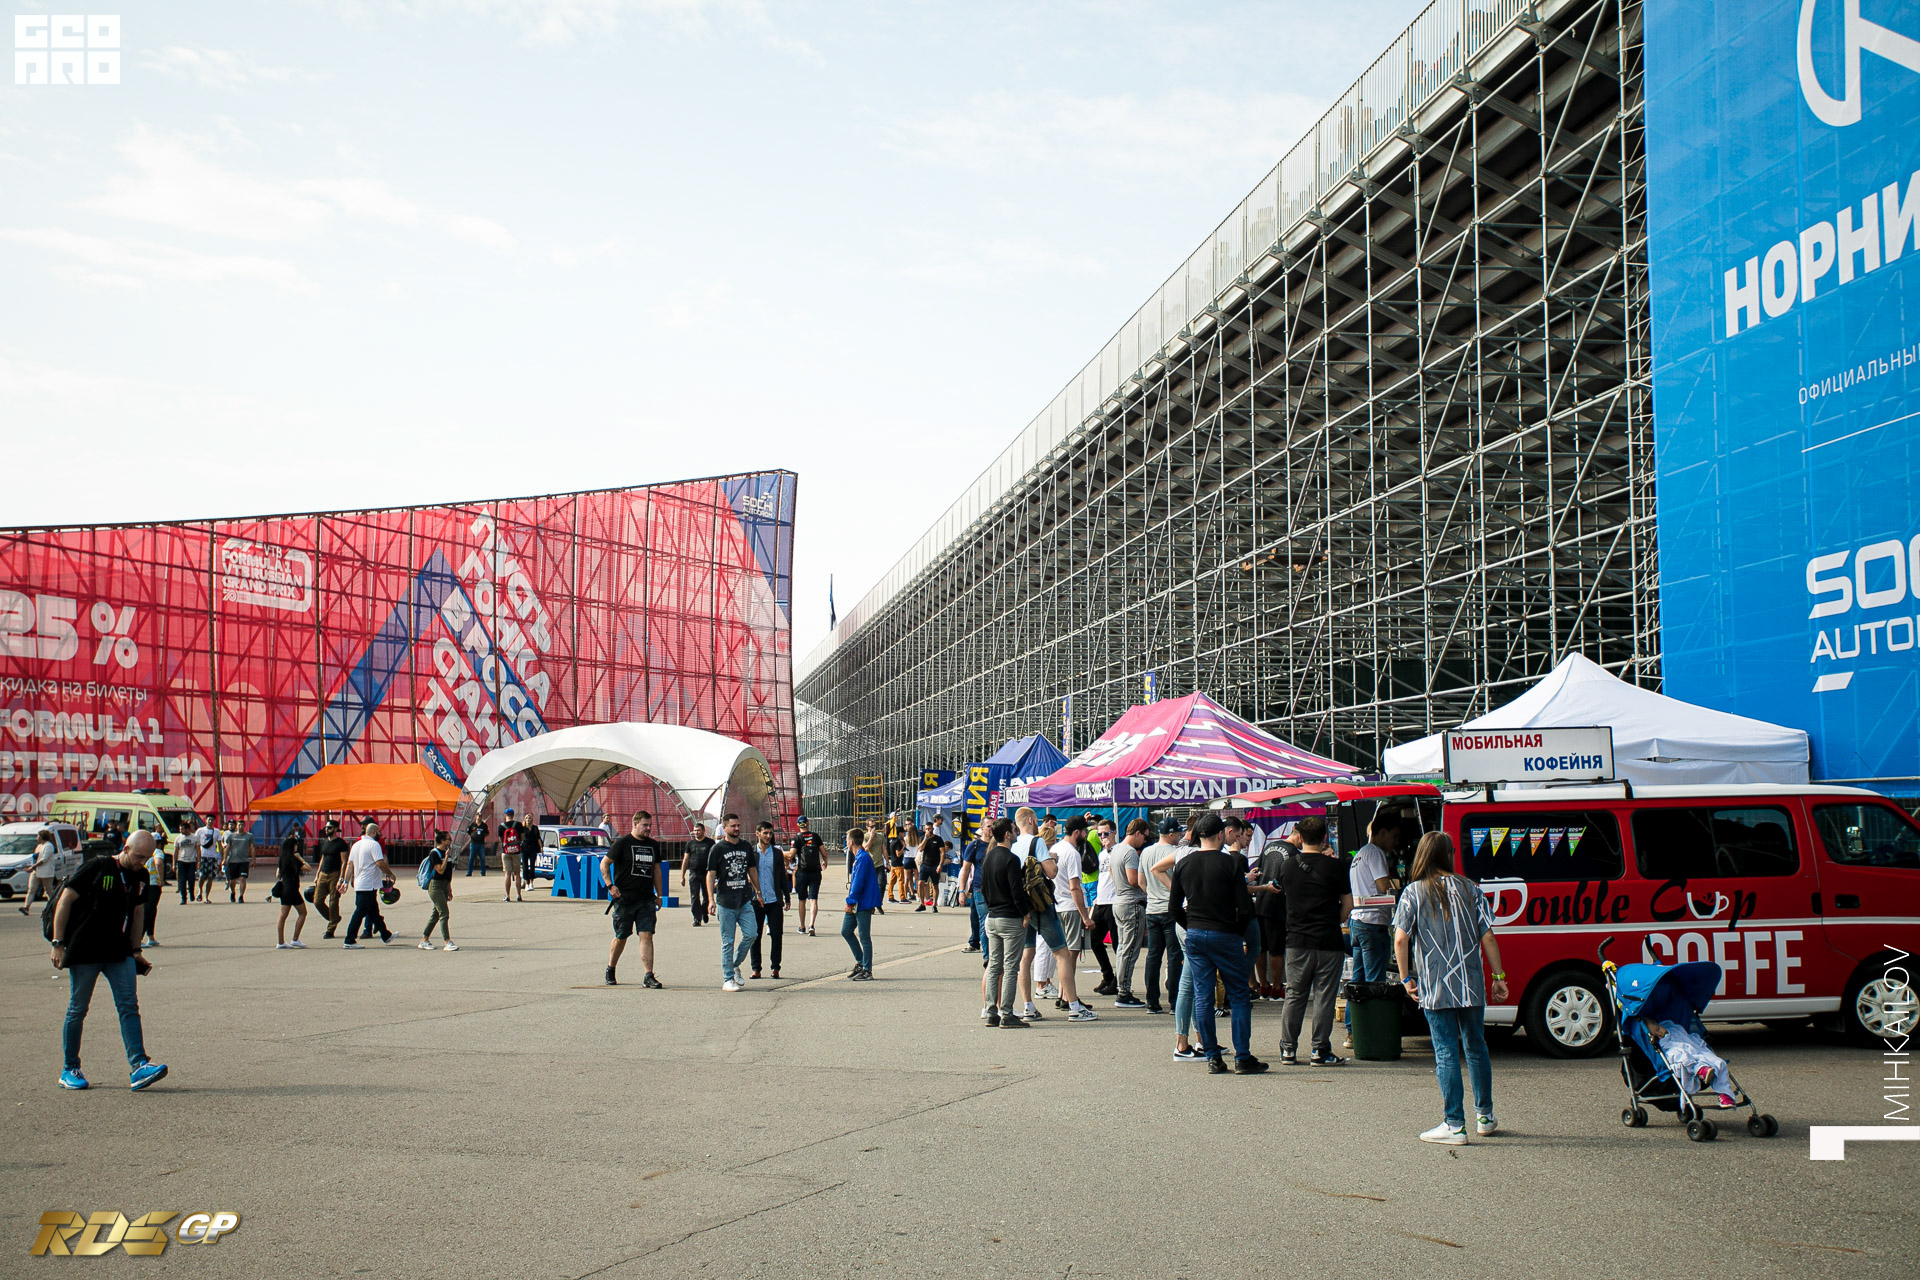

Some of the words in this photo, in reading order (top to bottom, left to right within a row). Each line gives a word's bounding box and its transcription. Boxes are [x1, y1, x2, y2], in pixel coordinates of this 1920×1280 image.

[1798, 343, 1920, 405] ОФИЦИАЛЬНЫ
[222, 550, 283, 572] FORMULA
[285, 561, 292, 573] 1
[264, 543, 283, 559] VTB
[222, 562, 250, 578] VTB
[251, 567, 303, 587] RUSSIAN
[470, 507, 551, 653] ПУСТЬ
[1806, 533, 1920, 619] SO
[222, 576, 267, 593] GRAND
[269, 583, 296, 599] PRIX
[0, 589, 79, 661] 25
[91, 601, 139, 669] %
[458, 550, 550, 713] ГОНКА
[1810, 615, 1920, 664] AUTO
[441, 586, 471, 633] В
[462, 621, 548, 742] РОСС
[62, 681, 82, 695] на
[86, 681, 147, 701] билеты
[148, 718, 164, 743] 1
[1452, 734, 1543, 750] МОБИЛЬНАЯ
[0, 751, 58, 780] ВТБ
[63, 752, 202, 783] ГРАН-ПРИ
[1524, 753, 1603, 771] КОФЕЙНЯ
[1130, 778, 1228, 800] RUSSIAN
[635, 854, 653, 862] PUMA
[1650, 878, 1757, 932] Cup
